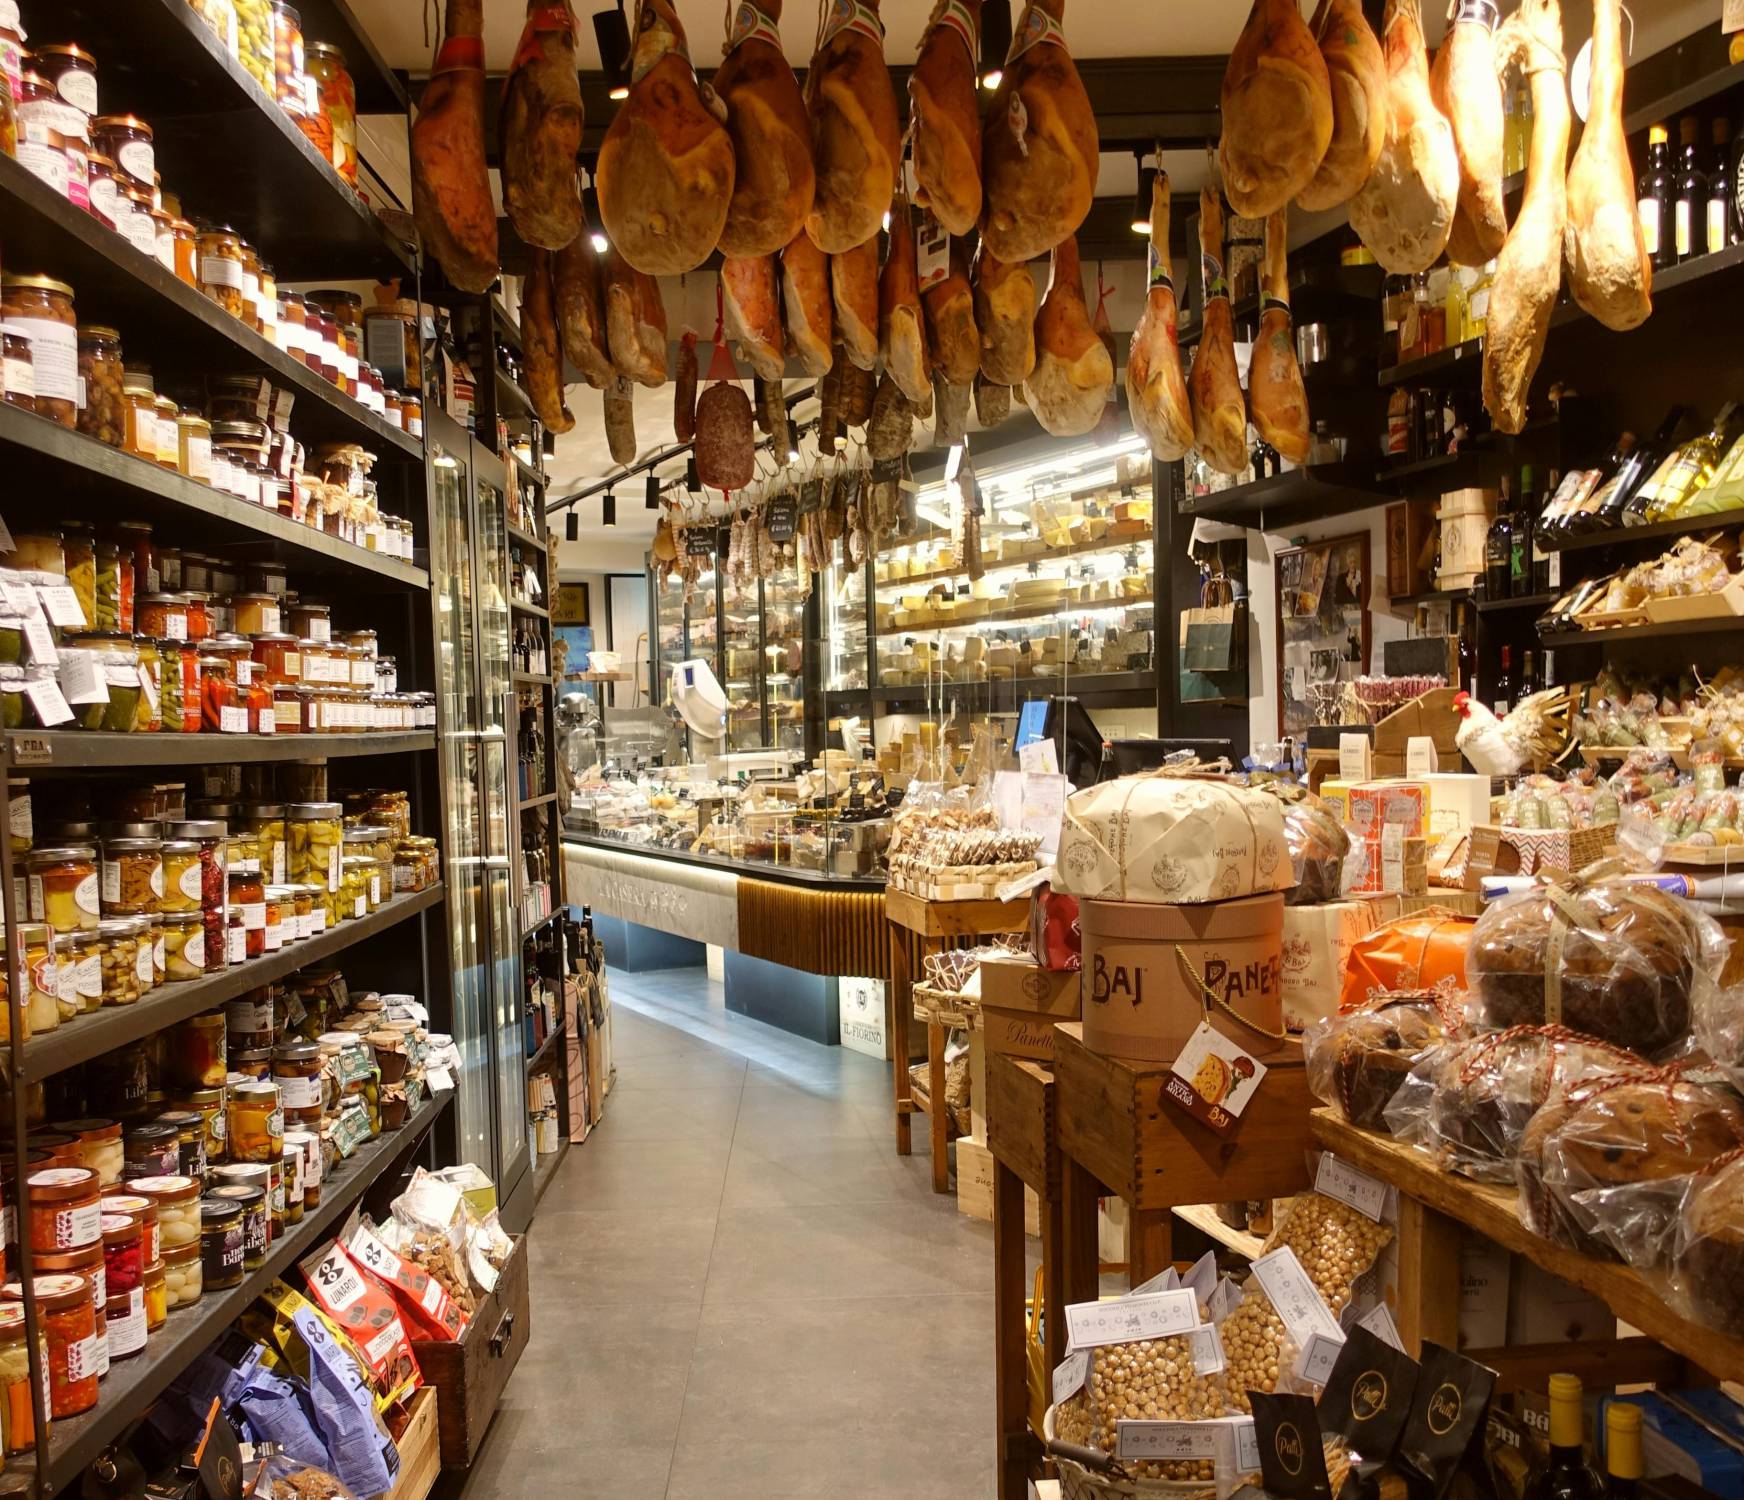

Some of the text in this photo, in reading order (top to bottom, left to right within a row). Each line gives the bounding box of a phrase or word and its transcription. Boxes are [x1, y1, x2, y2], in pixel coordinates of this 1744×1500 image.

[1092, 953, 1144, 1010] BAJ
[1165, 1085, 1193, 1106] MILANO
[1207, 1106, 1229, 1128] BAJ
[330, 1277, 359, 1305] LUNARDI
